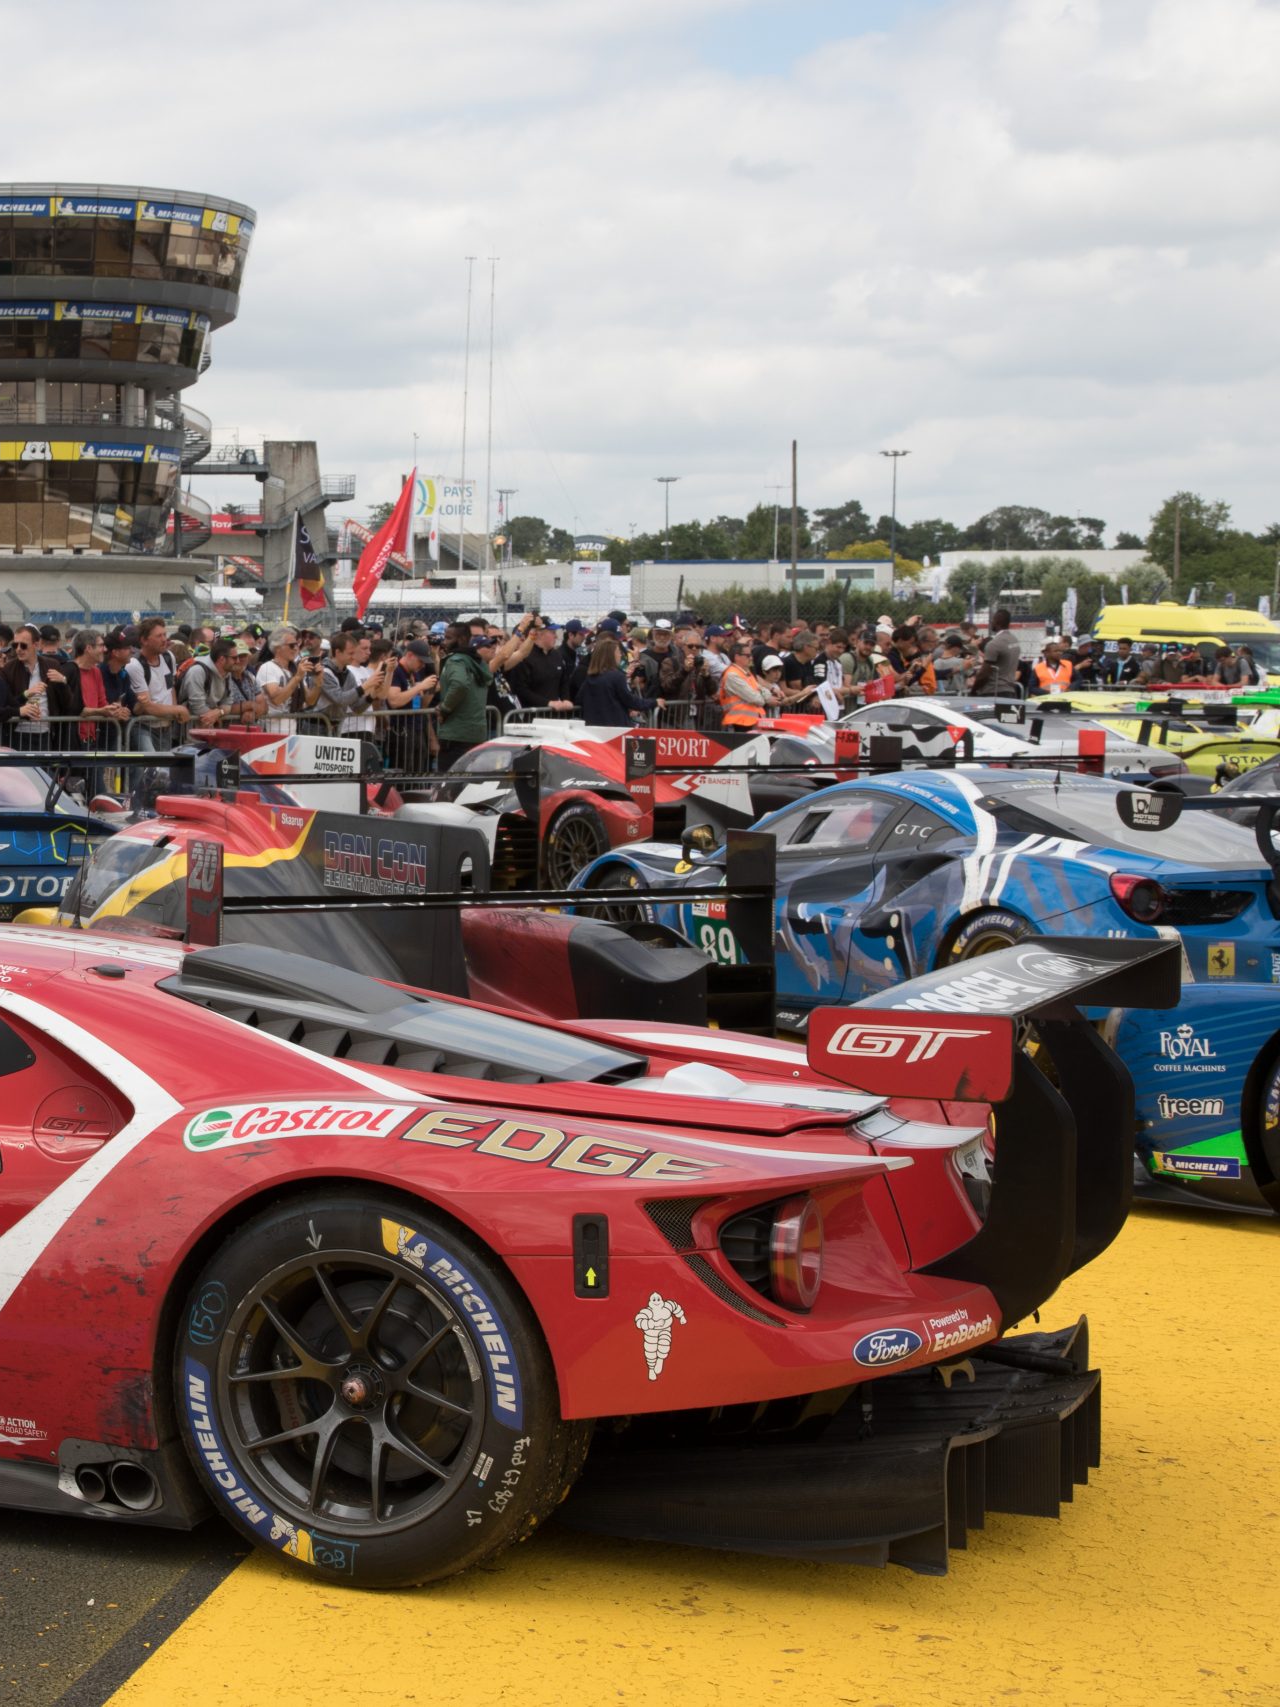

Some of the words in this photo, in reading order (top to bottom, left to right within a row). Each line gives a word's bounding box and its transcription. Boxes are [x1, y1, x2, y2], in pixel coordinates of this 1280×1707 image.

[76, 204, 132, 215] MICHELIN
[157, 210, 200, 222] MICHELIN
[81, 308, 133, 318] MICHELIN
[97, 448, 144, 457] MICHELIN
[443, 486, 472, 497] PAYS
[439, 504, 472, 516] LOIRE
[575, 542, 608, 551] UNLOP
[315, 744, 356, 763] UNITED
[658, 736, 710, 758] SPORT
[314, 762, 354, 774] AUTOSPORTS
[630, 785, 651, 794] MOTUL
[707, 777, 740, 786] BANORTE
[281, 812, 304, 829] Skaarup
[188, 840, 216, 894] 20
[324, 830, 372, 876] DAN
[377, 838, 427, 887] CON
[710, 902, 726, 913] TOT
[966, 914, 1015, 936] MICHELIN
[700, 924, 737, 965] 89
[826, 1022, 992, 1064] GT
[1160, 1031, 1216, 1060] ROYAL
[1159, 1095, 1224, 1118] freem
[231, 1105, 392, 1139] Castrol
[401, 1109, 726, 1183] EDGE
[1175, 1160, 1228, 1172] MICHELIN
[930, 1310, 957, 1329] Powered
[957, 1308, 969, 1323] by
[430, 1257, 517, 1413] MICHELIN
[932, 1315, 993, 1353] EcoBoost
[867, 1334, 910, 1363] Ford
[6, 1417, 36, 1429] ACTION
[6, 1425, 23, 1436] ROAD
[23, 1428, 48, 1439] SAFETY
[188, 1373, 268, 1526] MICHELIN
